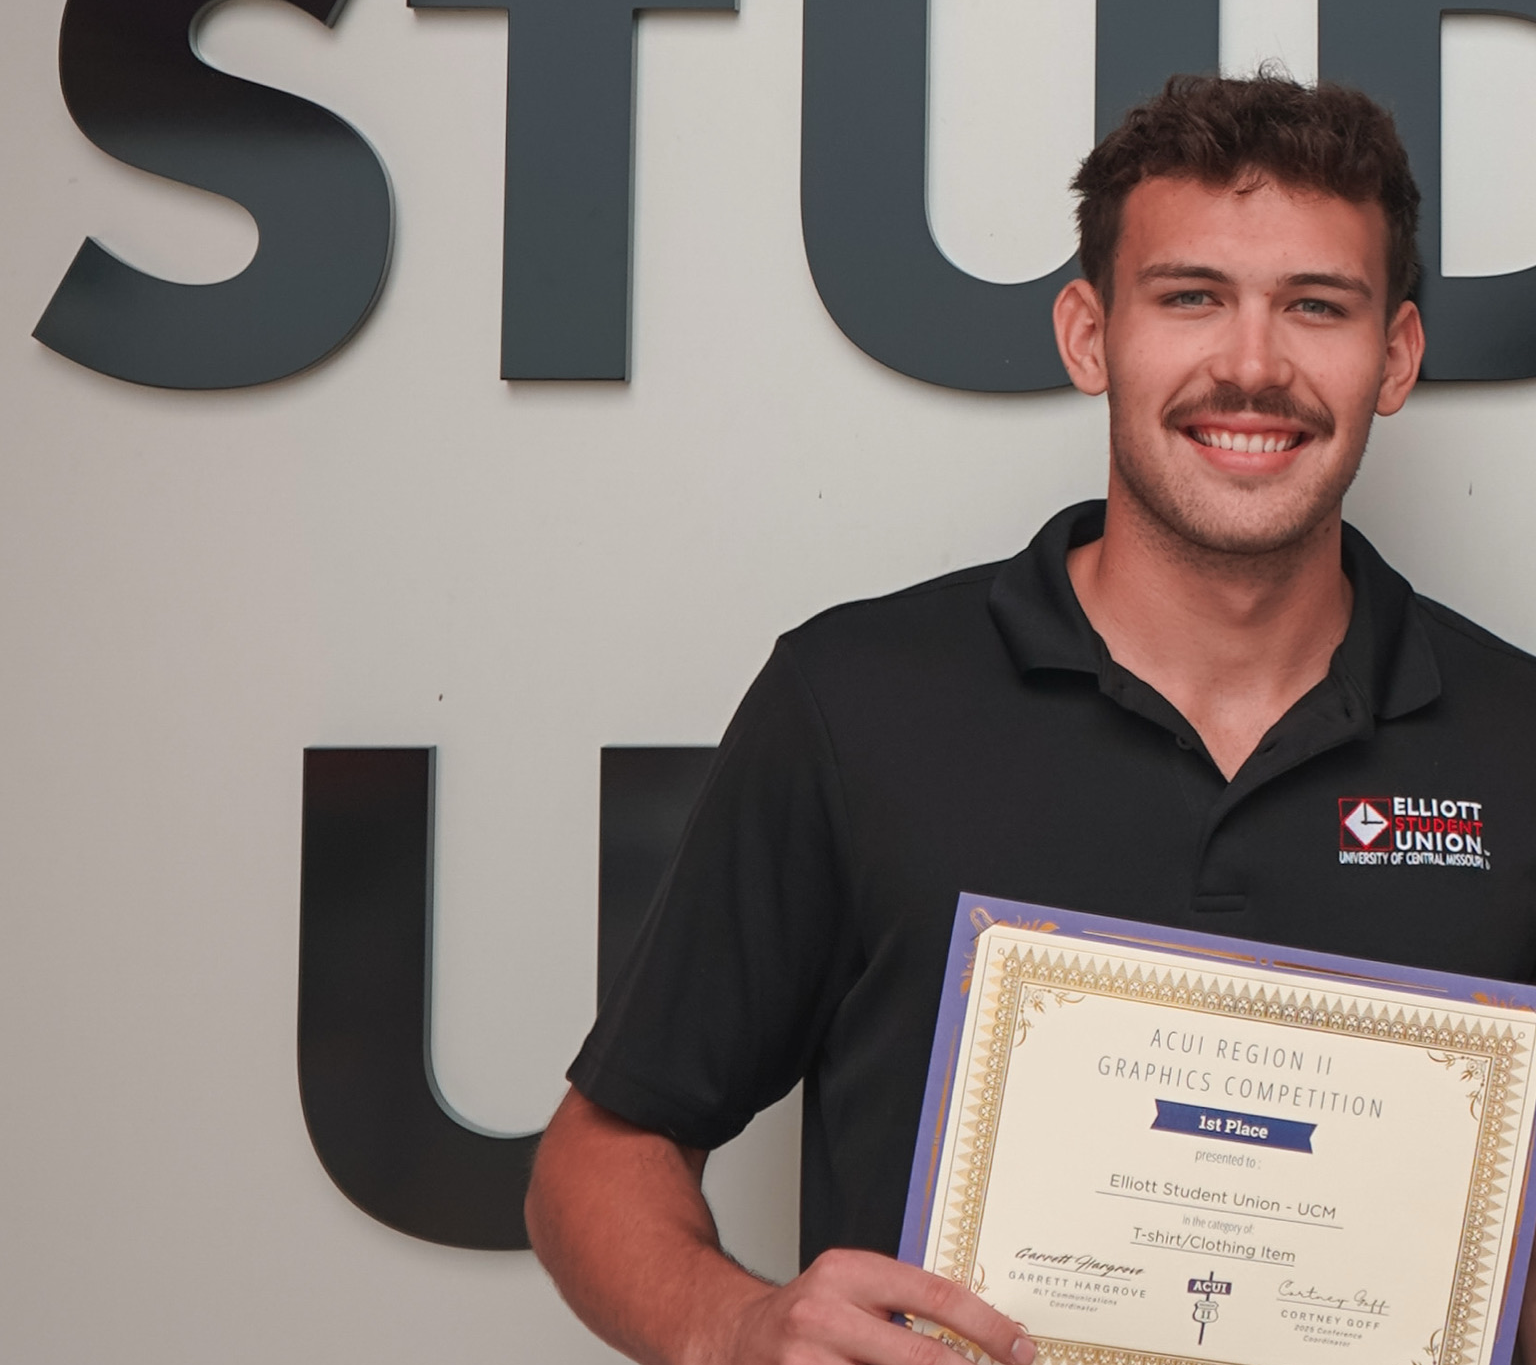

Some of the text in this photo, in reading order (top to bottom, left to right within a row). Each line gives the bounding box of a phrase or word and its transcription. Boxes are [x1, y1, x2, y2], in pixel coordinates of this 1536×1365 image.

[1393, 796, 1482, 821] ELLIOTT
[1395, 817, 1483, 835] STUDENT
[1395, 831, 1483, 855] UNION
[1338, 850, 1389, 865] UNIVERSITY
[1390, 852, 1404, 865] OF
[1406, 852, 1446, 867] CENTRAL
[1150, 1028, 1332, 1075] ACUI REGION II
[1098, 1055, 1384, 1119] GRAPHICS COMPETITION
[1198, 1115, 1268, 1139] 1st Place
[1195, 1148, 1244, 1168] presented
[1109, 1173, 1158, 1194] Elliott
[1163, 1182, 1228, 1205] Student
[1233, 1192, 1281, 1213] Union
[1297, 1202, 1336, 1220] UCM
[1182, 1215, 1191, 1225] in
[1192, 1215, 1206, 1228] the
[1207, 1219, 1242, 1235] category
[1133, 1226, 1296, 1263] T-shirt/Clothing Item
[1015, 1247, 1073, 1265] Garrett
[1008, 1270, 1147, 1299] GARRETT HARGROVE
[1193, 1281, 1228, 1294] ACUI
[1278, 1279, 1349, 1309] Cortney
[1049, 1300, 1098, 1313] Coordinator
[1051, 1290, 1118, 1306] Communications
[1281, 1309, 1381, 1330] CORTNEY GOFF
[1303, 1335, 1351, 1348] Coordinator
[1317, 1327, 1363, 1340] Conference
